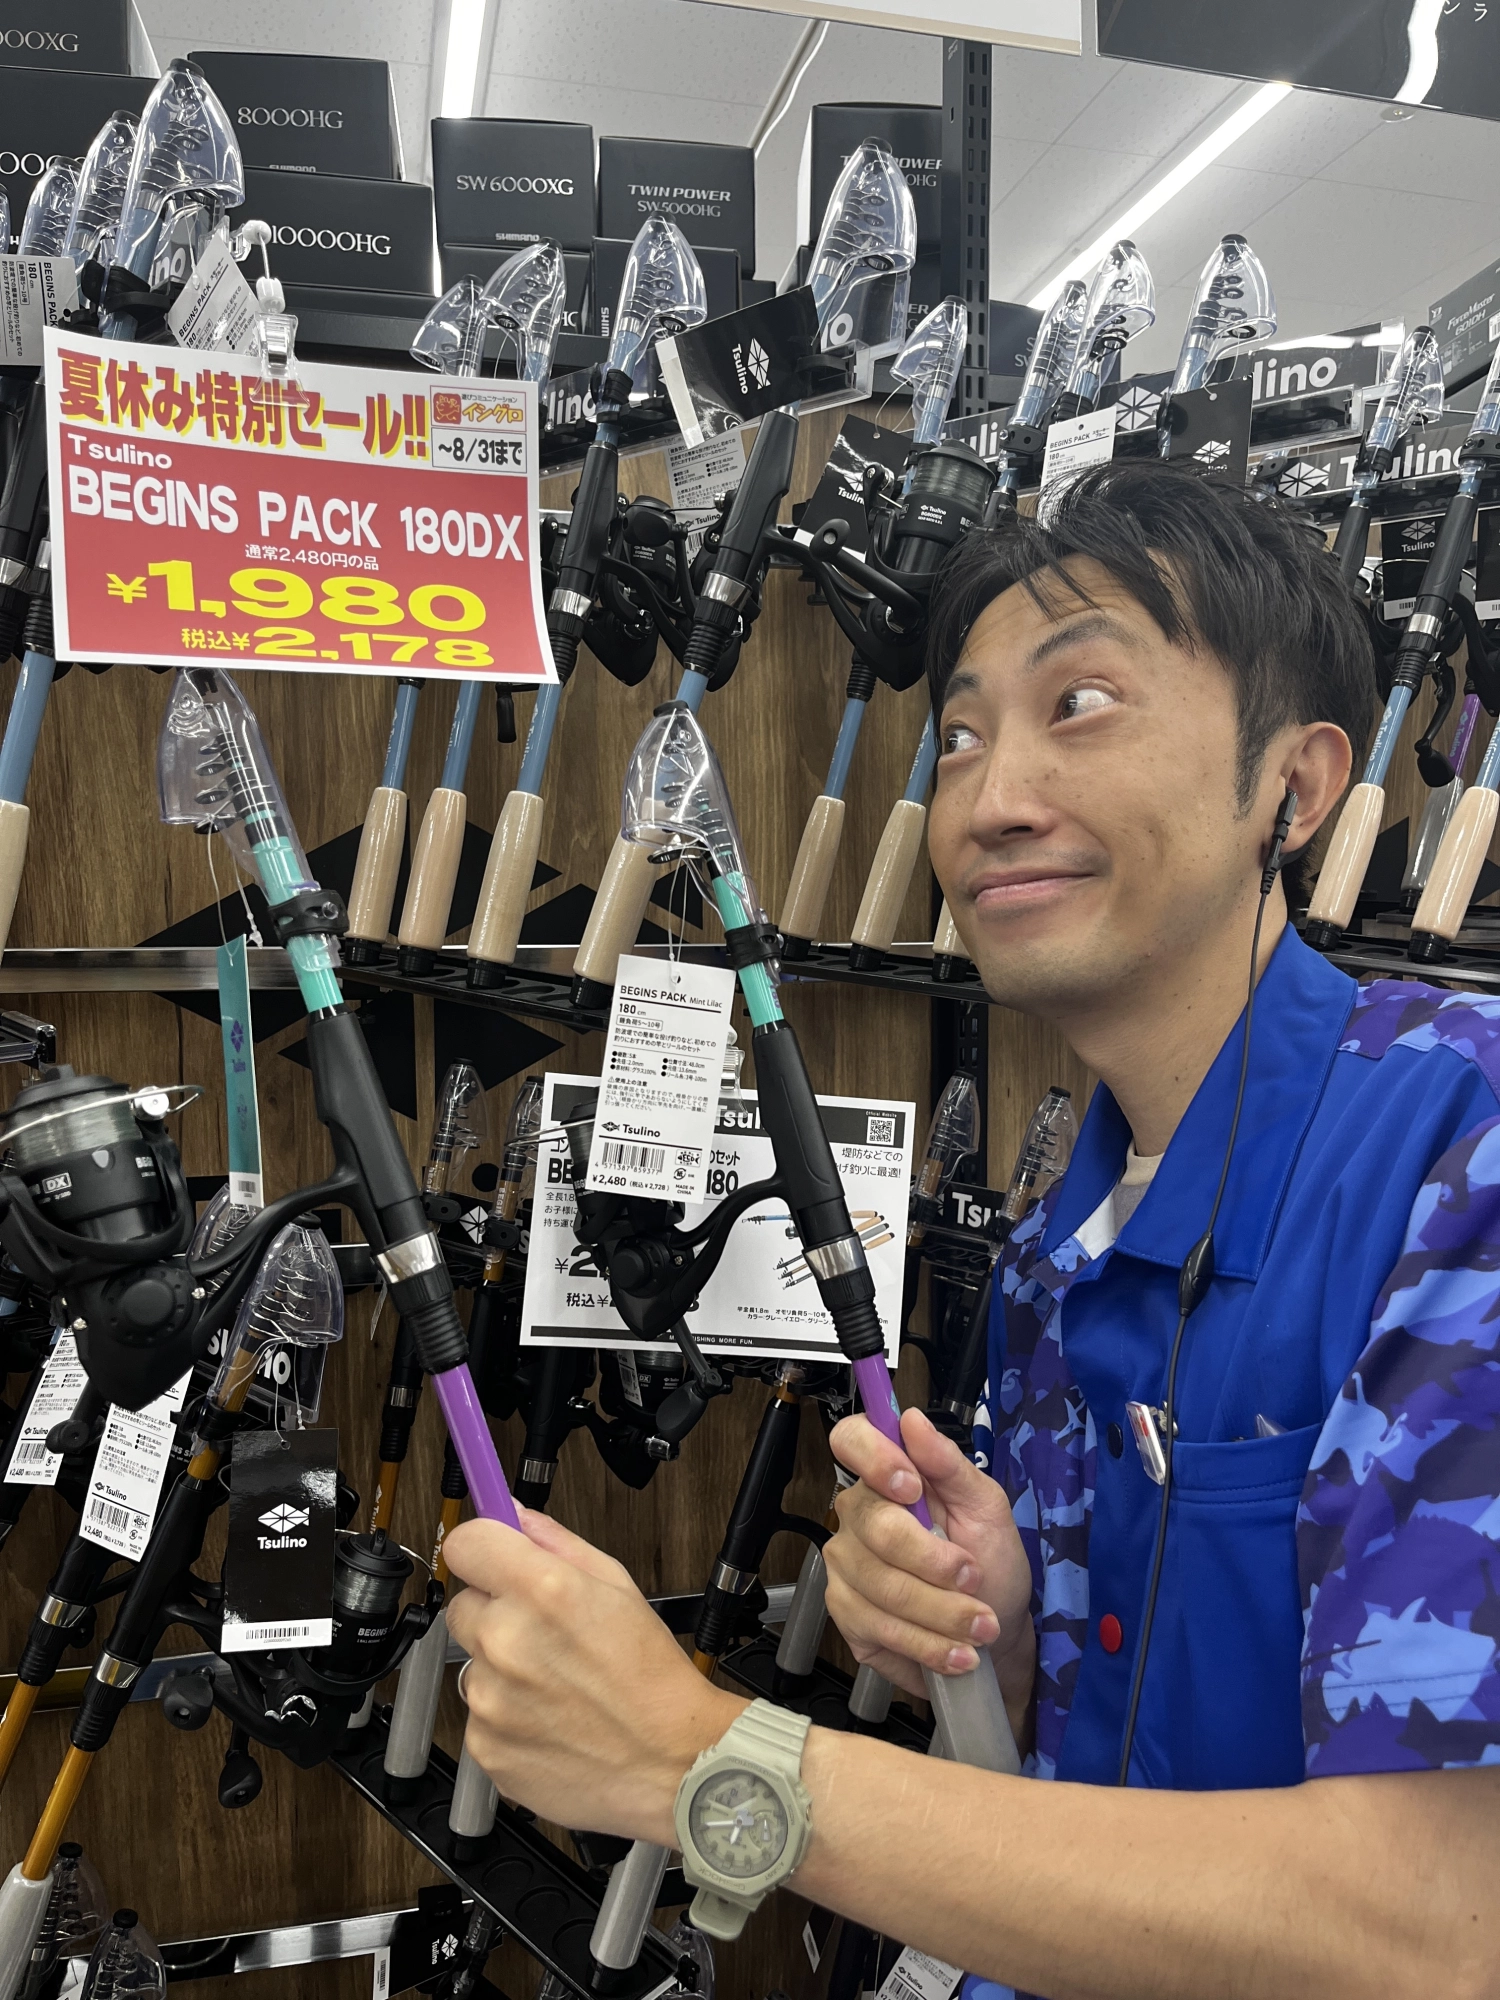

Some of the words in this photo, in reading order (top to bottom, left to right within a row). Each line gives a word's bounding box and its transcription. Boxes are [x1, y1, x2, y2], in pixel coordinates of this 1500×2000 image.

[0, 29, 79, 52] 00XG
[627, 184, 671, 198] TWIN
[672, 186, 731, 202] POWER
[495, 232, 541, 243] SHIMANO
[27, 262, 38, 279] 180
[43, 262, 56, 299] BEGINS
[178, 305, 199, 338] BEGINS
[197, 282, 212, 308] PACK
[731, 343, 749, 395] Tsulino
[57, 346, 430, 462] 夏休み特別セール!!
[462, 402, 524, 424] イシグロ
[1050, 437, 1073, 450] BEGINS
[1073, 432, 1092, 443] PACK
[67, 432, 173, 470] Tsulino
[1049, 452, 1060, 461] 180
[68, 463, 239, 535] BEGINS
[257, 490, 383, 549] PACK
[399, 506, 525, 562] 180DX
[1401, 540, 1436, 553] Tsulino
[244, 543, 379, 572] 通常2,480円の品
[106, 559, 487, 633] ¥1,980
[180, 625, 495, 668] 税込¥2,178
[1369, 724, 1388, 762] Tsulino
[1448, 726, 1466, 758] Tsulino
[620, 984, 658, 999] BEGINS
[660, 990, 687, 1003] PACK
[689, 997, 706, 1006] Mint
[706, 999, 723, 1008] Lilac
[619, 1003, 636, 1014] 180
[622, 1123, 661, 1138] Tsulino
[841, 1147, 903, 1163] 堤防などでの
[46, 1176, 67, 1191] DX
[592, 1174, 627, 1187] ¥2,480
[32, 1427, 49, 1435] Tsulino
[105, 1485, 127, 1501] Tsulino
[257, 1535, 308, 1550] Tsulino
[904, 1971, 924, 1990] Tsulino
